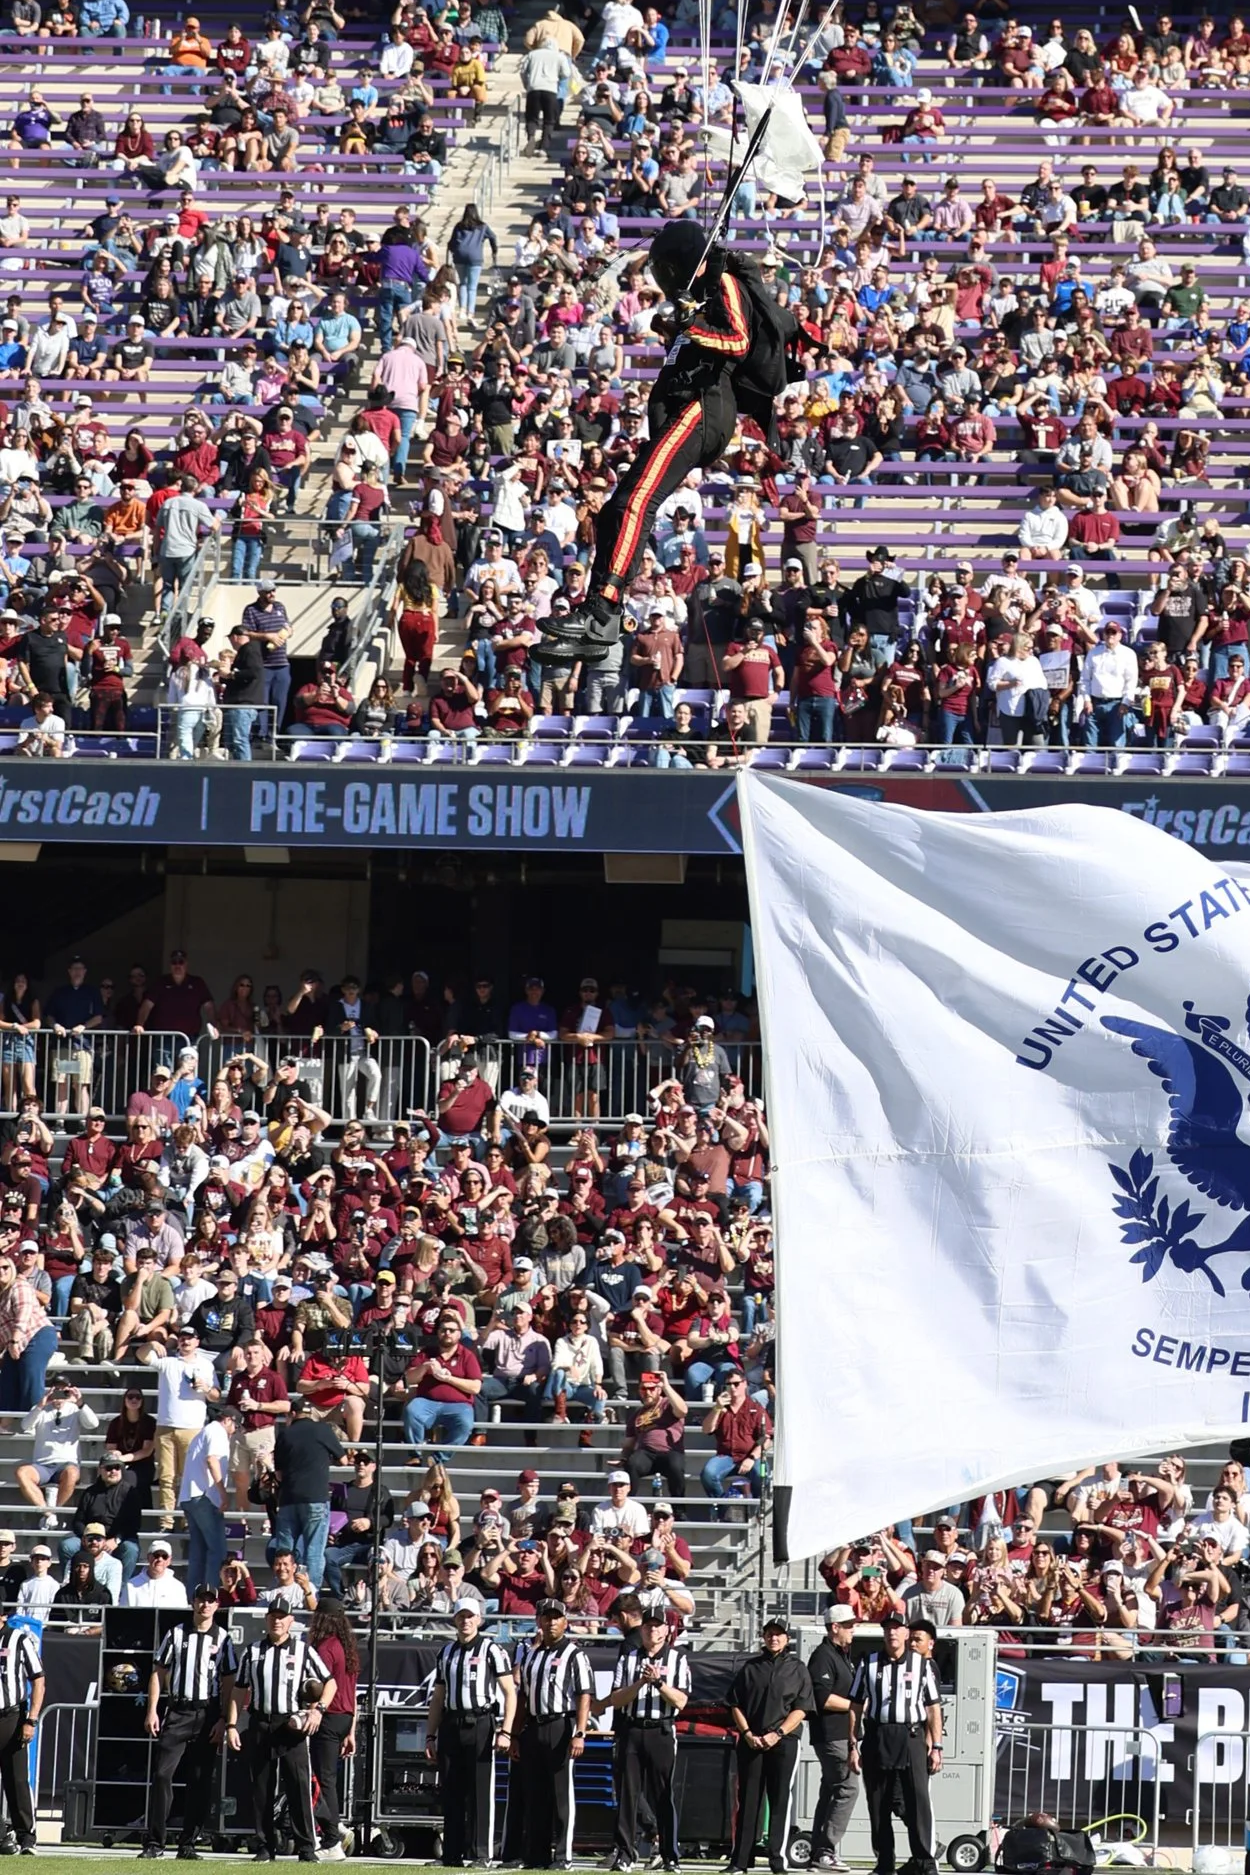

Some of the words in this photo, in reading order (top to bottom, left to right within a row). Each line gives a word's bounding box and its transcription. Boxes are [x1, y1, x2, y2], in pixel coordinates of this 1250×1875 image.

[0, 776, 161, 826] rstCash
[251, 781, 457, 837] PRE-GAME
[468, 785, 591, 838] SHOW
[1015, 946, 1140, 1071] UNITED
[1208, 1034, 1218, 1045] E
[1041, 1683, 1175, 1782] THE
[941, 1772, 961, 1780] DATA
